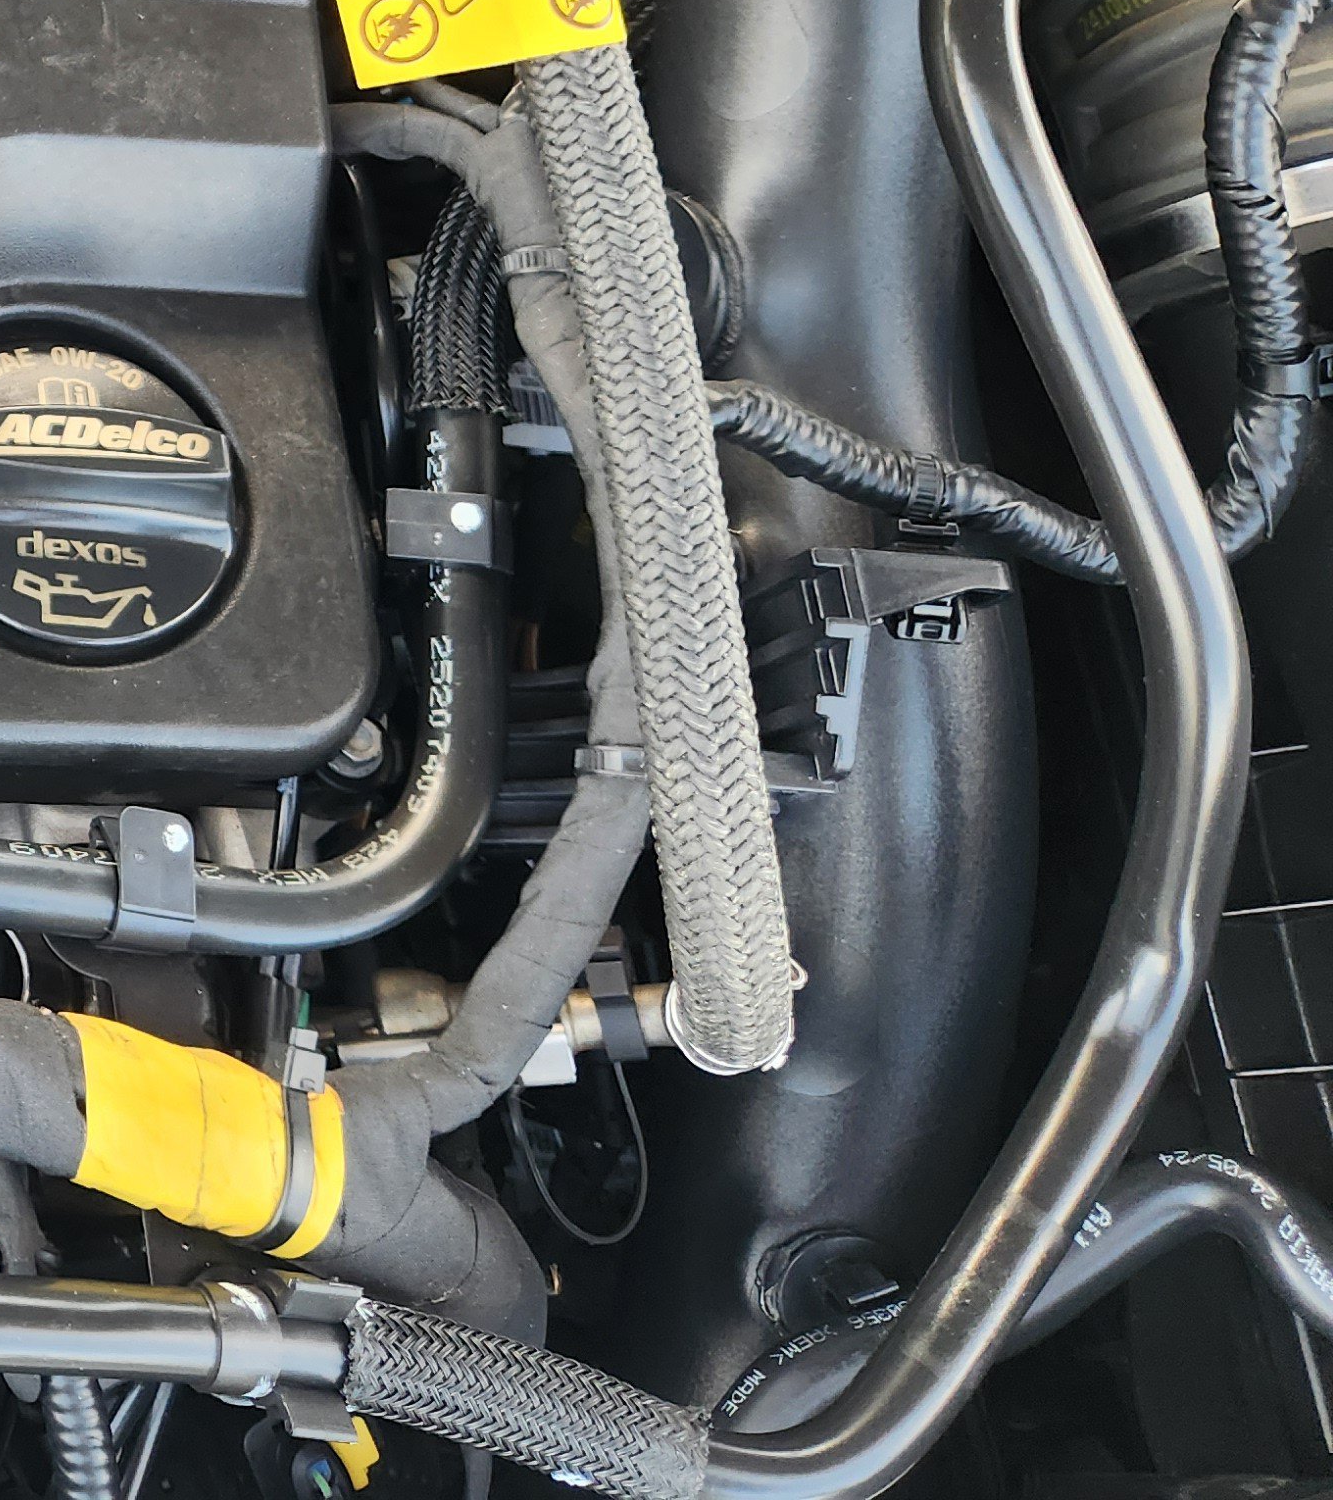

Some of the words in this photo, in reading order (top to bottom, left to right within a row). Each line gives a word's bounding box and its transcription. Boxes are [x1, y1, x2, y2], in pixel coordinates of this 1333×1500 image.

[49, 345, 145, 391] 0W-20
[15, 529, 148, 569] dexos
[407, 634, 454, 815] 25207409
[251, 865, 332, 888] MEX
[719, 1368, 768, 1418] MADE
